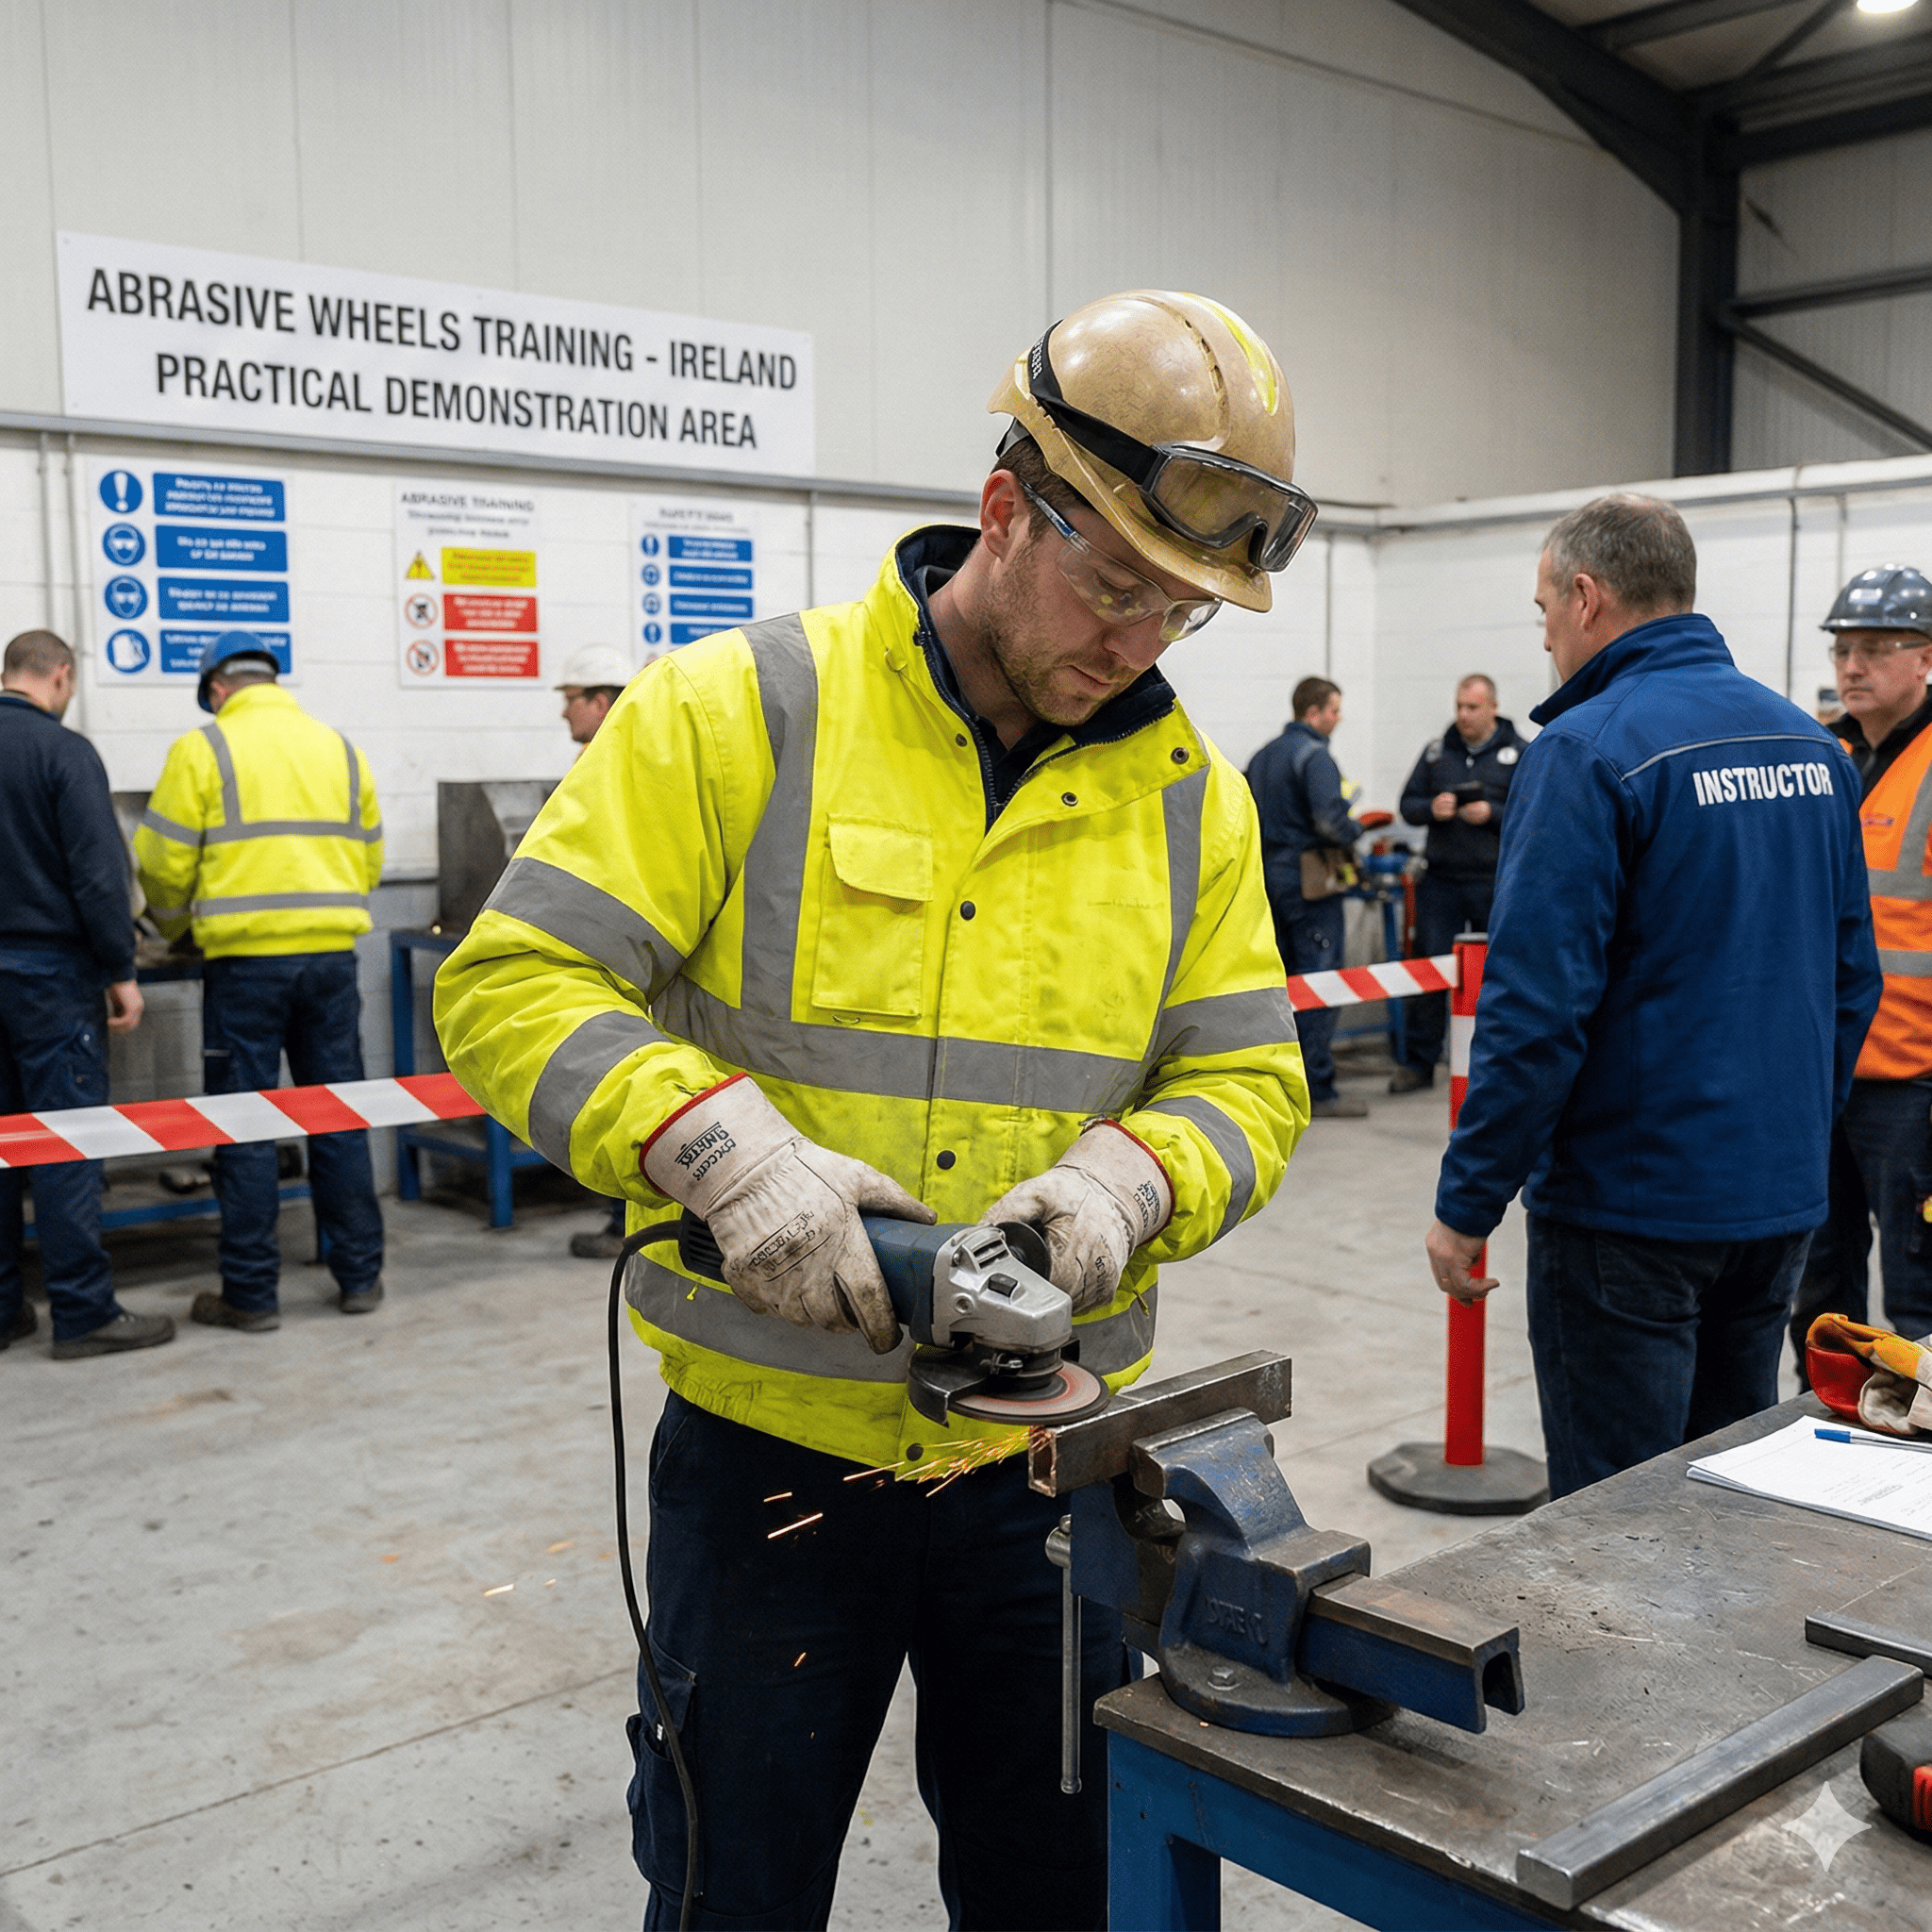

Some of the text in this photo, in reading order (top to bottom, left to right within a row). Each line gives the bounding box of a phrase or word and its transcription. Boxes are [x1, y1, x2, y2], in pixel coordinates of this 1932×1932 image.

[88, 268, 296, 333] ABRASIVE
[309, 295, 460, 352] WHEELS
[474, 316, 634, 372] TRAINING
[671, 341, 798, 391] IRELAND
[158, 353, 758, 449] PRACTICAL DEMONSTRATION AREA
[1692, 762, 1834, 806] INSTRUCTOR
